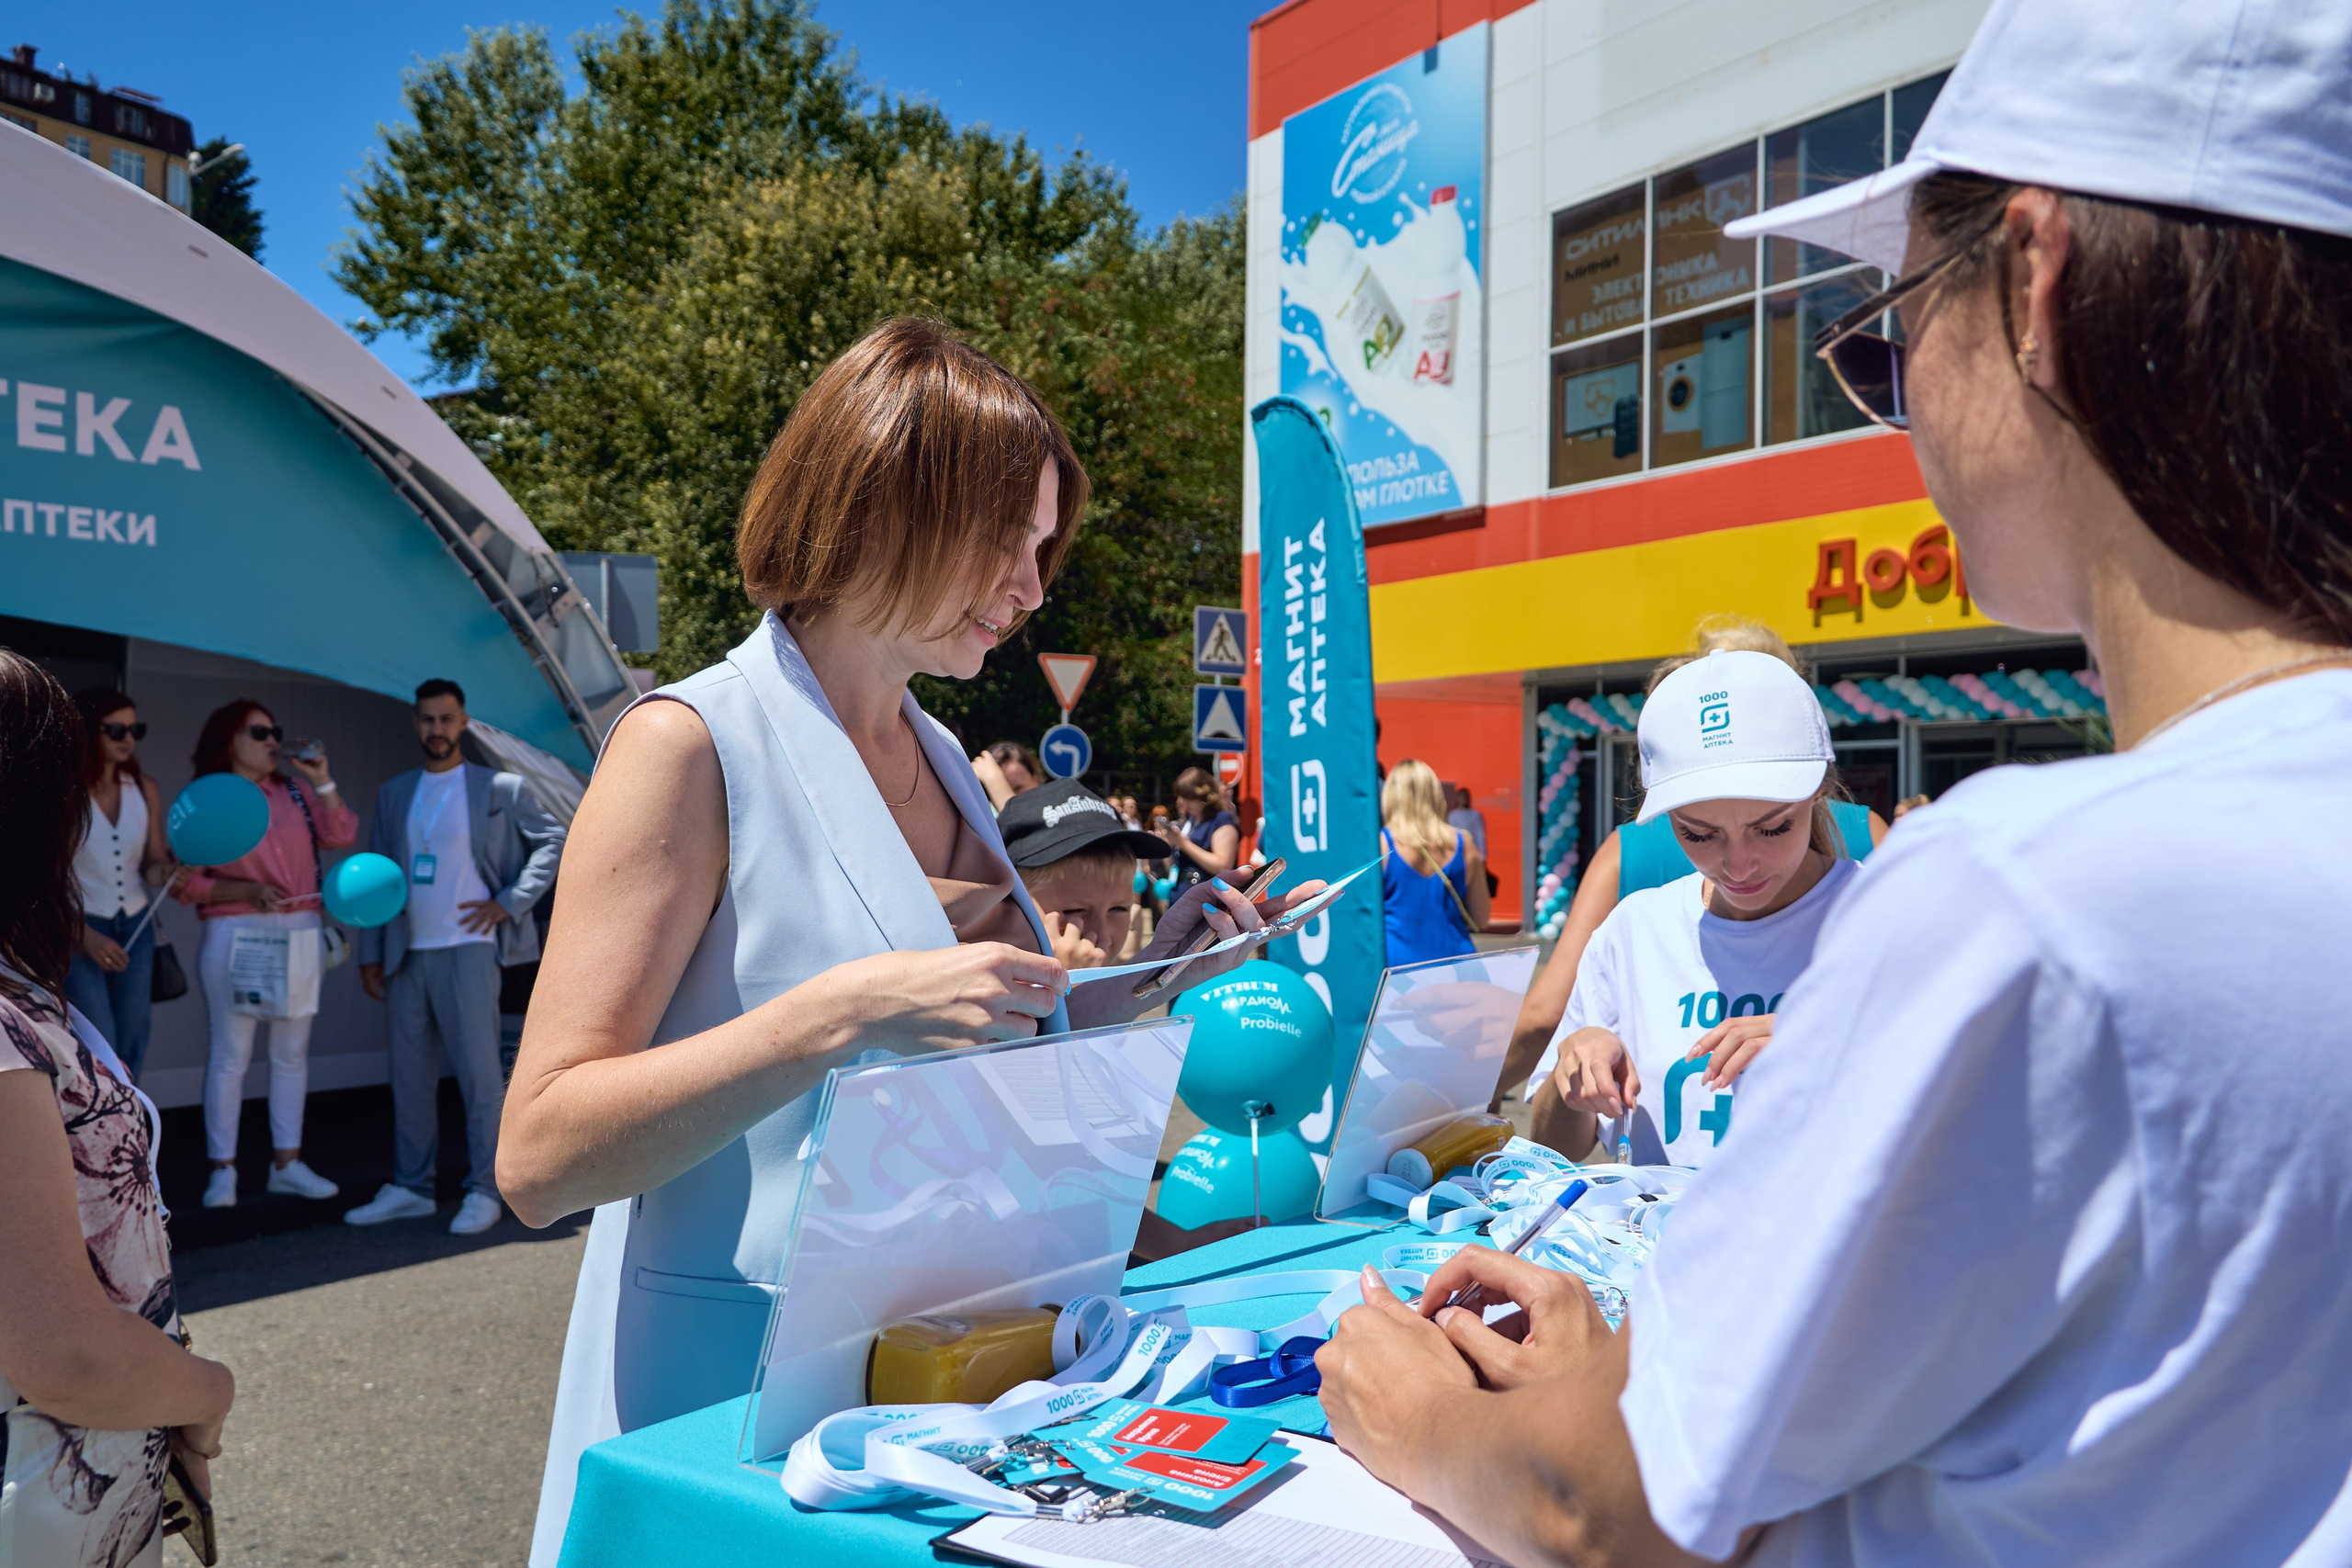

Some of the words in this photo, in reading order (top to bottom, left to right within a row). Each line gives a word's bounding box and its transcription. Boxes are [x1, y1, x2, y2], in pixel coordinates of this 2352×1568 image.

[1591, 251, 1718, 305] ЭЛЕКТОНИКА
[0, 378, 202, 471] ЕКА
[1347, 449, 1420, 486] ПОЛЬЗА
[1379, 470, 1450, 506] ГЛОТКЕ
[0, 498, 156, 547] ПТЕКИ
[1309, 516, 1327, 728] АПТЕКА
[1284, 536, 1306, 738] МАГНИТ
[1699, 691, 1728, 704] 1000
[1702, 732, 1732, 742] МАГНИТ
[1703, 739, 1734, 749] АПТЕКА
[1200, 981, 1278, 1001] VITRUM
[1678, 991, 1788, 1029] 100
[1240, 1015, 1302, 1037] Probielle
[1511, 1159, 1536, 1169] 1000
[1137, 1327, 1160, 1357] 1000
[1046, 1393, 1074, 1414] 1000
[907, 1426, 942, 1440] МАГНИТ
[957, 1444, 990, 1457] 000
[1169, 1469, 1225, 1487] Анохина
[1193, 1468, 1232, 1482] Елена
[1164, 1482, 1216, 1501] 1000
